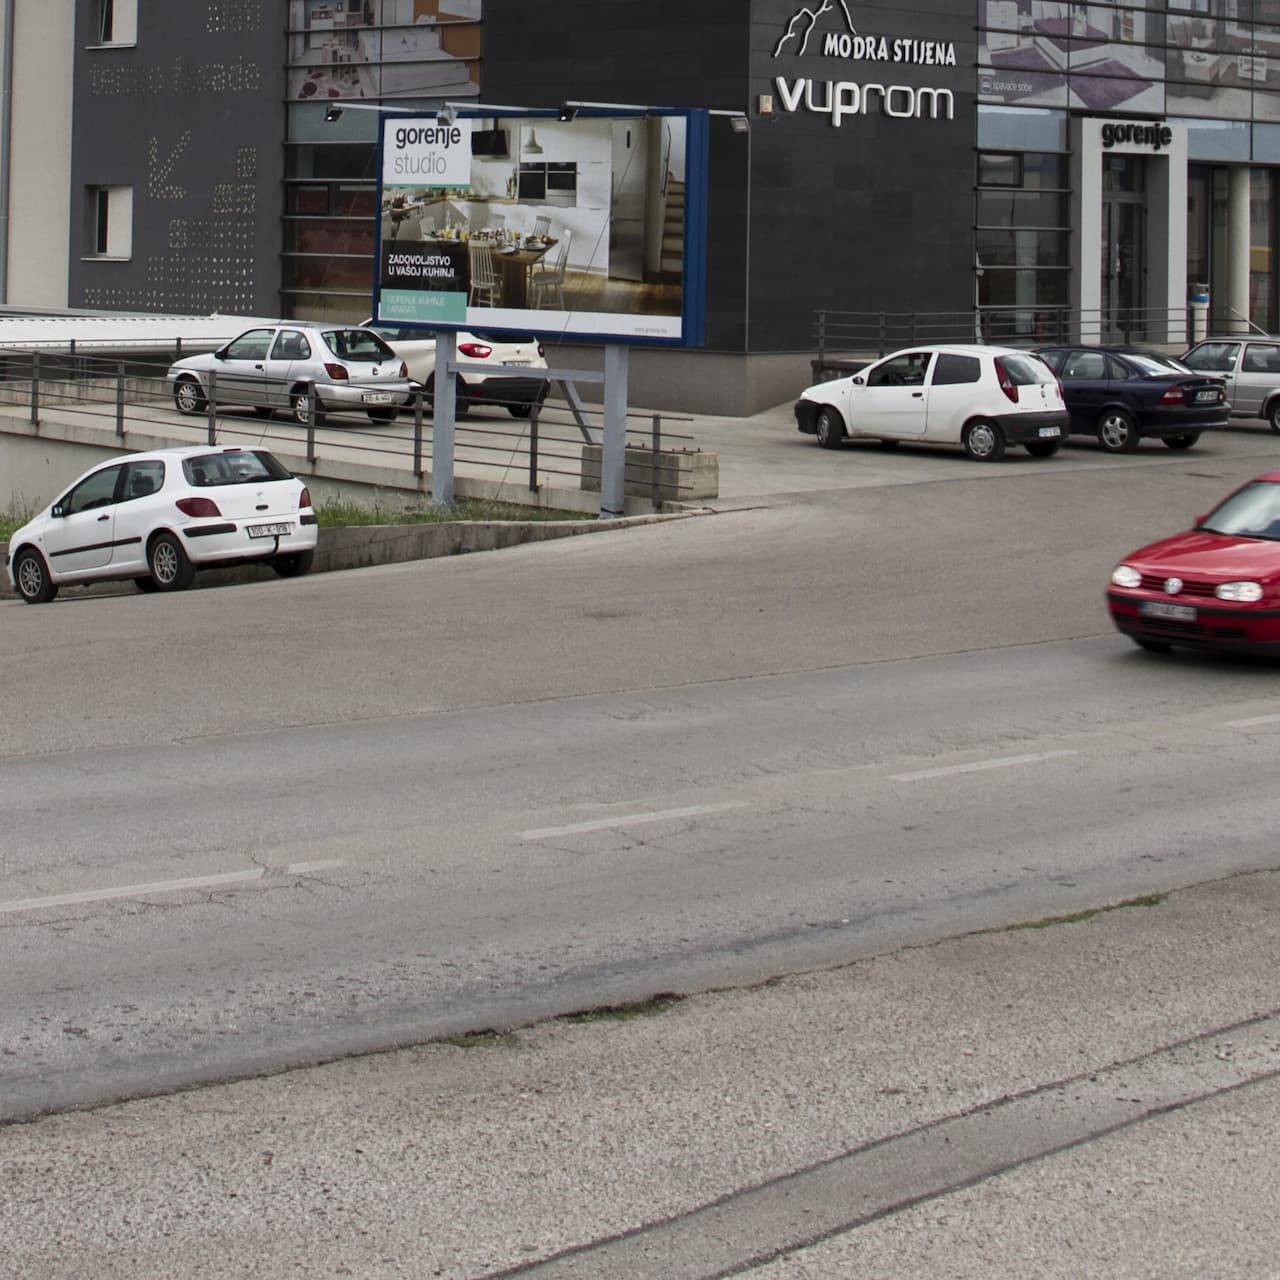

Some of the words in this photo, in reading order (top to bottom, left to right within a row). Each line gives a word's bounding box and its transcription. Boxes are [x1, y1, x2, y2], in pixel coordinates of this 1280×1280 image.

[824, 33, 888, 61] MODRA
[894, 39, 957, 66] STIJENA
[776, 76, 954, 127] vuprom
[396, 127, 461, 149] gorenje
[1102, 123, 1172, 150] gorenje
[394, 152, 447, 174] studio
[388, 254, 451, 266] ZADOVOLJSTVO
[388, 266, 394, 275] U
[395, 265, 421, 277] VAŠOJ
[422, 267, 455, 277] KUHINJI
